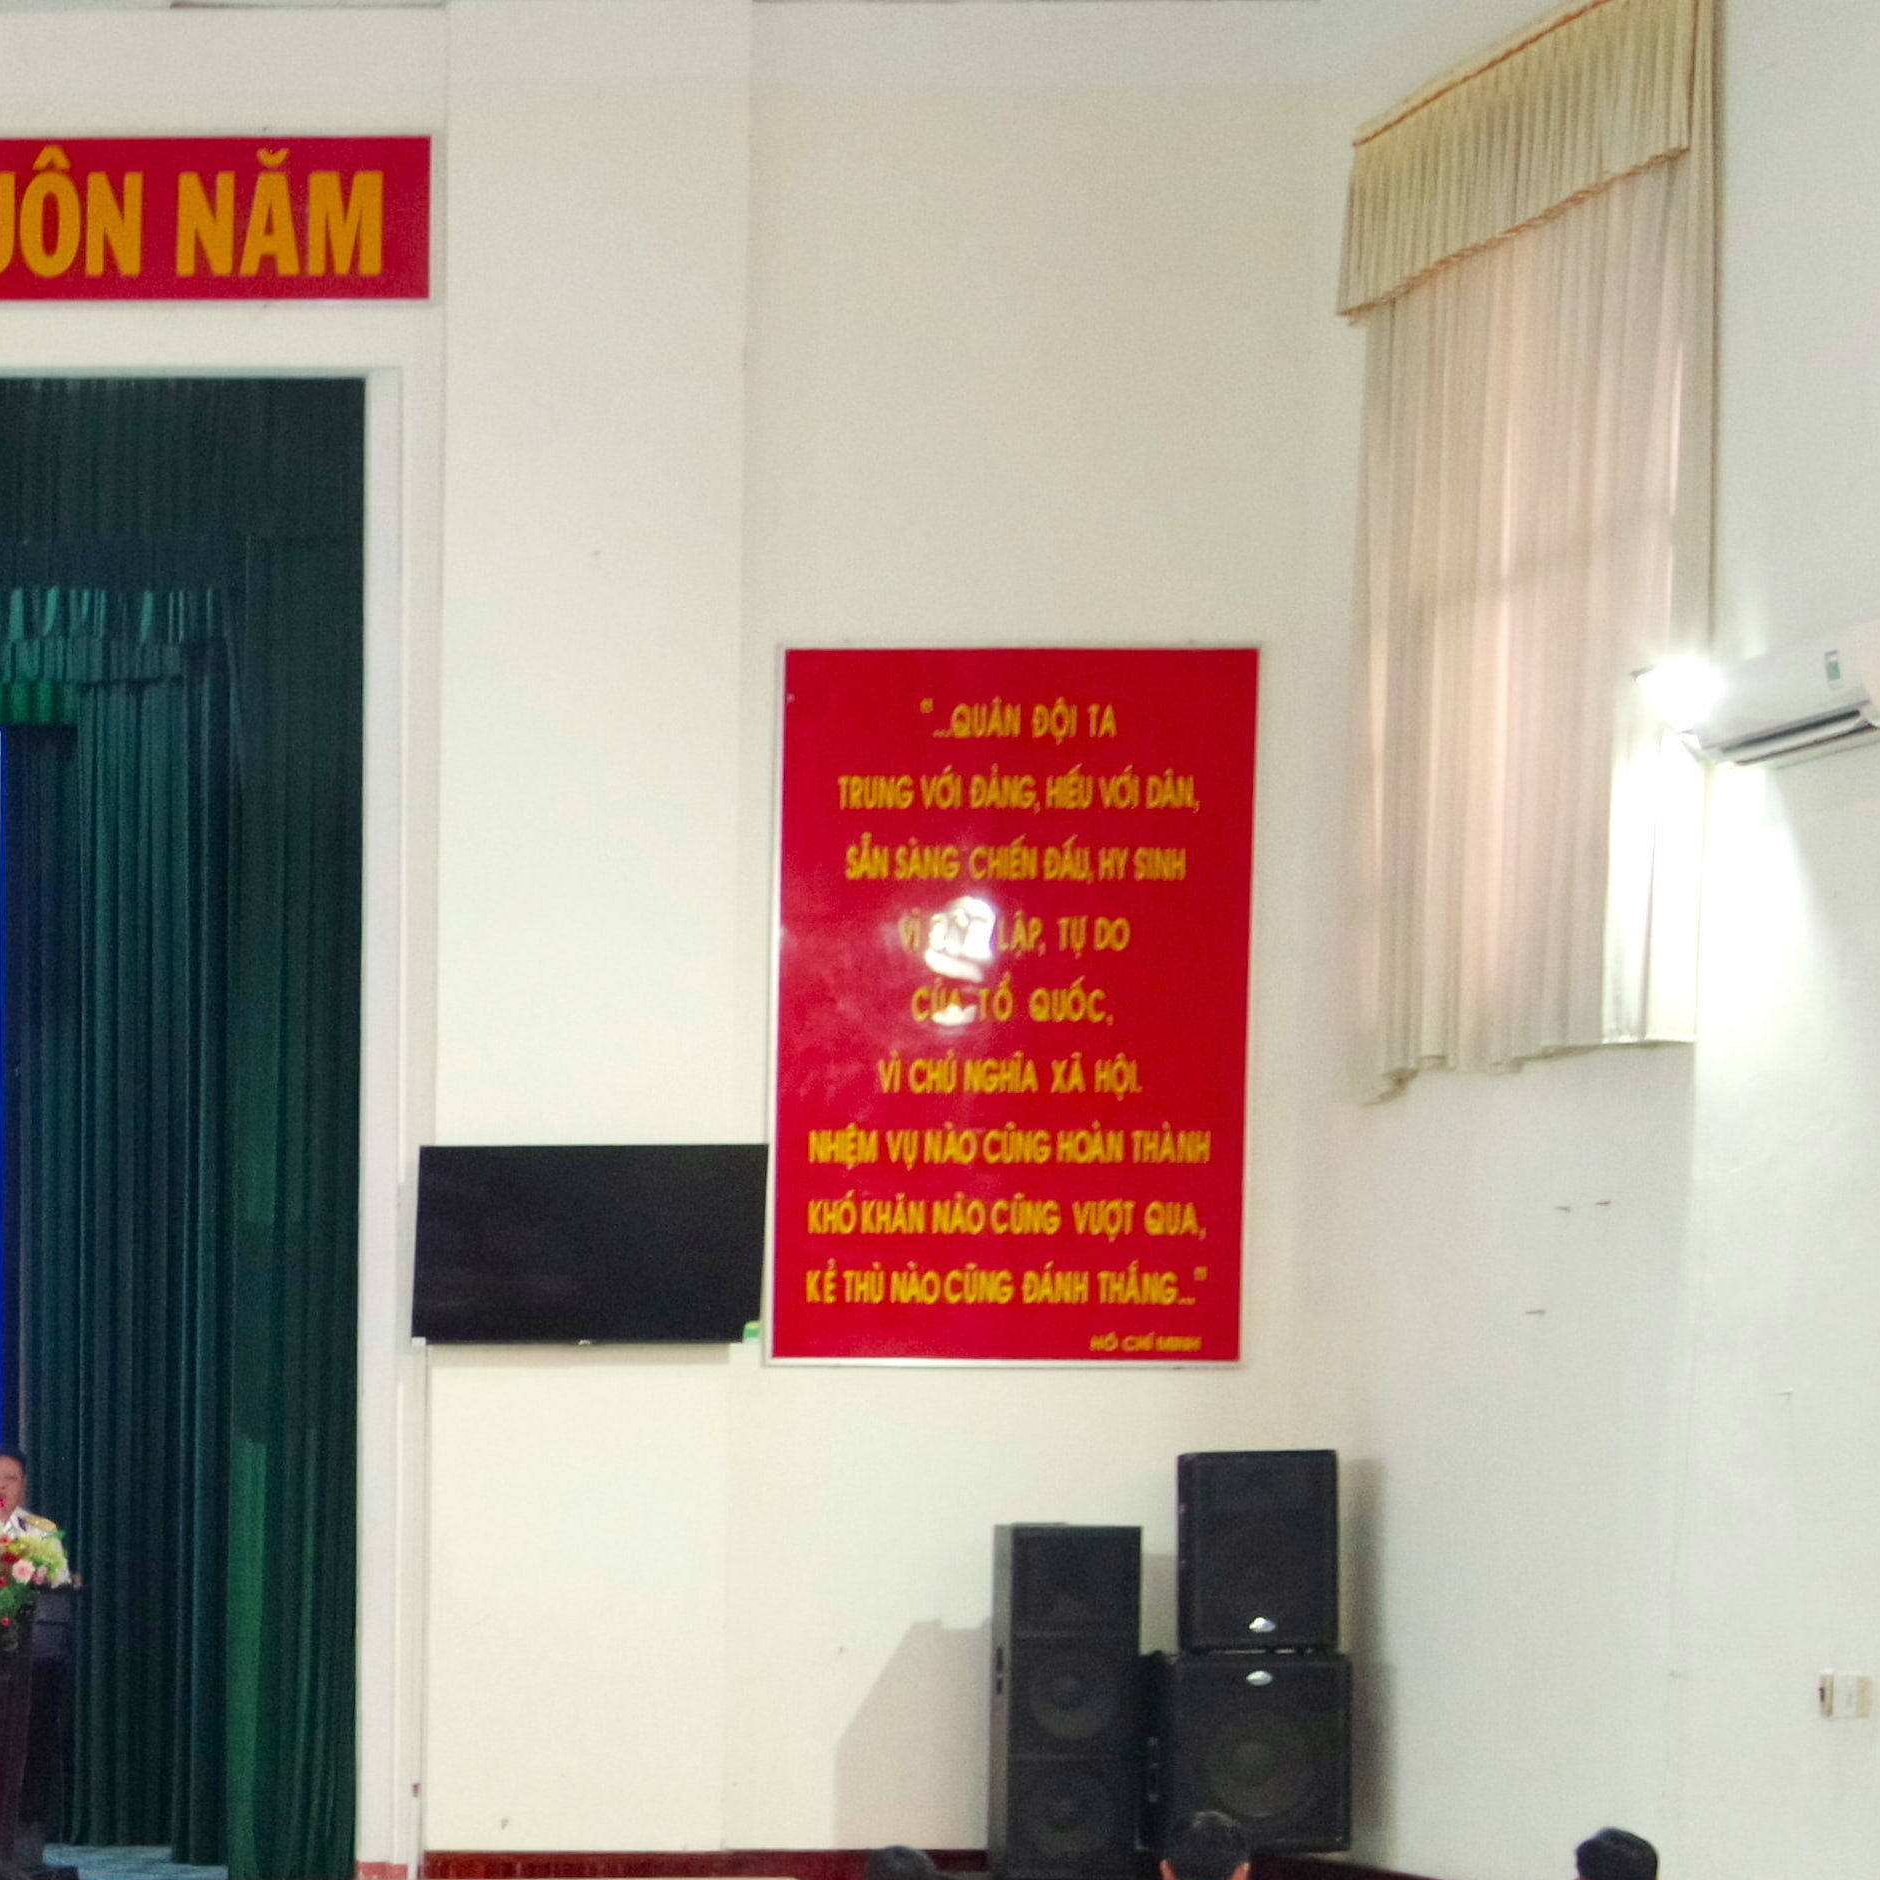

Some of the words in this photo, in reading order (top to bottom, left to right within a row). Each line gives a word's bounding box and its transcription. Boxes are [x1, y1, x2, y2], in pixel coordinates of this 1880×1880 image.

[176, 147, 384, 276] NĂM
[1089, 704, 1117, 737] TA
[838, 775, 915, 809] TRUNG
[1099, 847, 1129, 880] HY
[1134, 847, 1187, 881] SINH
[1094, 917, 1131, 952] DO
